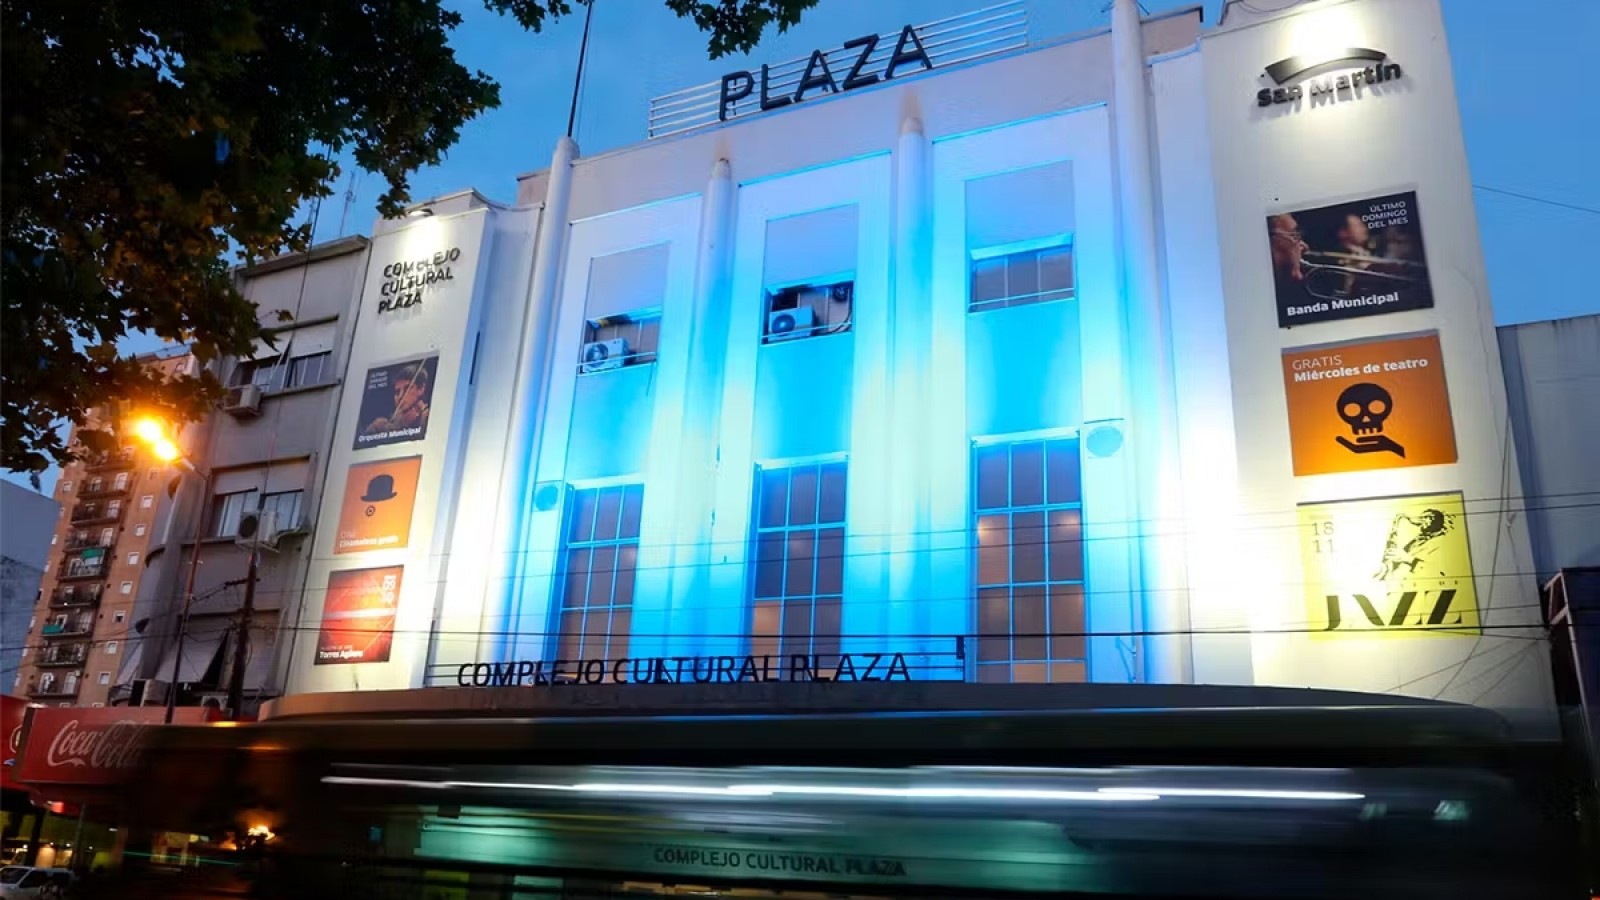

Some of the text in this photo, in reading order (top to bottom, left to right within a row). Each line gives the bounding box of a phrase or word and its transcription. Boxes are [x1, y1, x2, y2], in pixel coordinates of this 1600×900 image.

[719, 24, 932, 121] PLAZA
[1257, 62, 1401, 107] San Martín
[1362, 208, 1408, 222] DOMINGO
[1370, 200, 1406, 212] ÚLTIMO
[1368, 216, 1409, 229] DEL MES
[383, 247, 461, 278] COMPLEJO
[381, 266, 453, 296] CULTURAL
[378, 291, 422, 314] PLAZA
[1287, 291, 1399, 316] Banda Municipal
[1292, 355, 1343, 370] GRATIS
[1294, 358, 1428, 382] Miércoles de teatro
[388, 426, 421, 438] Municipal
[1311, 521, 1334, 536] 18
[1312, 539, 1335, 554] 11
[457, 651, 911, 688] COMPLEJO CULTURAL PLAZA
[653, 847, 907, 877] COMPLEJO CULTURAL PLAZA
